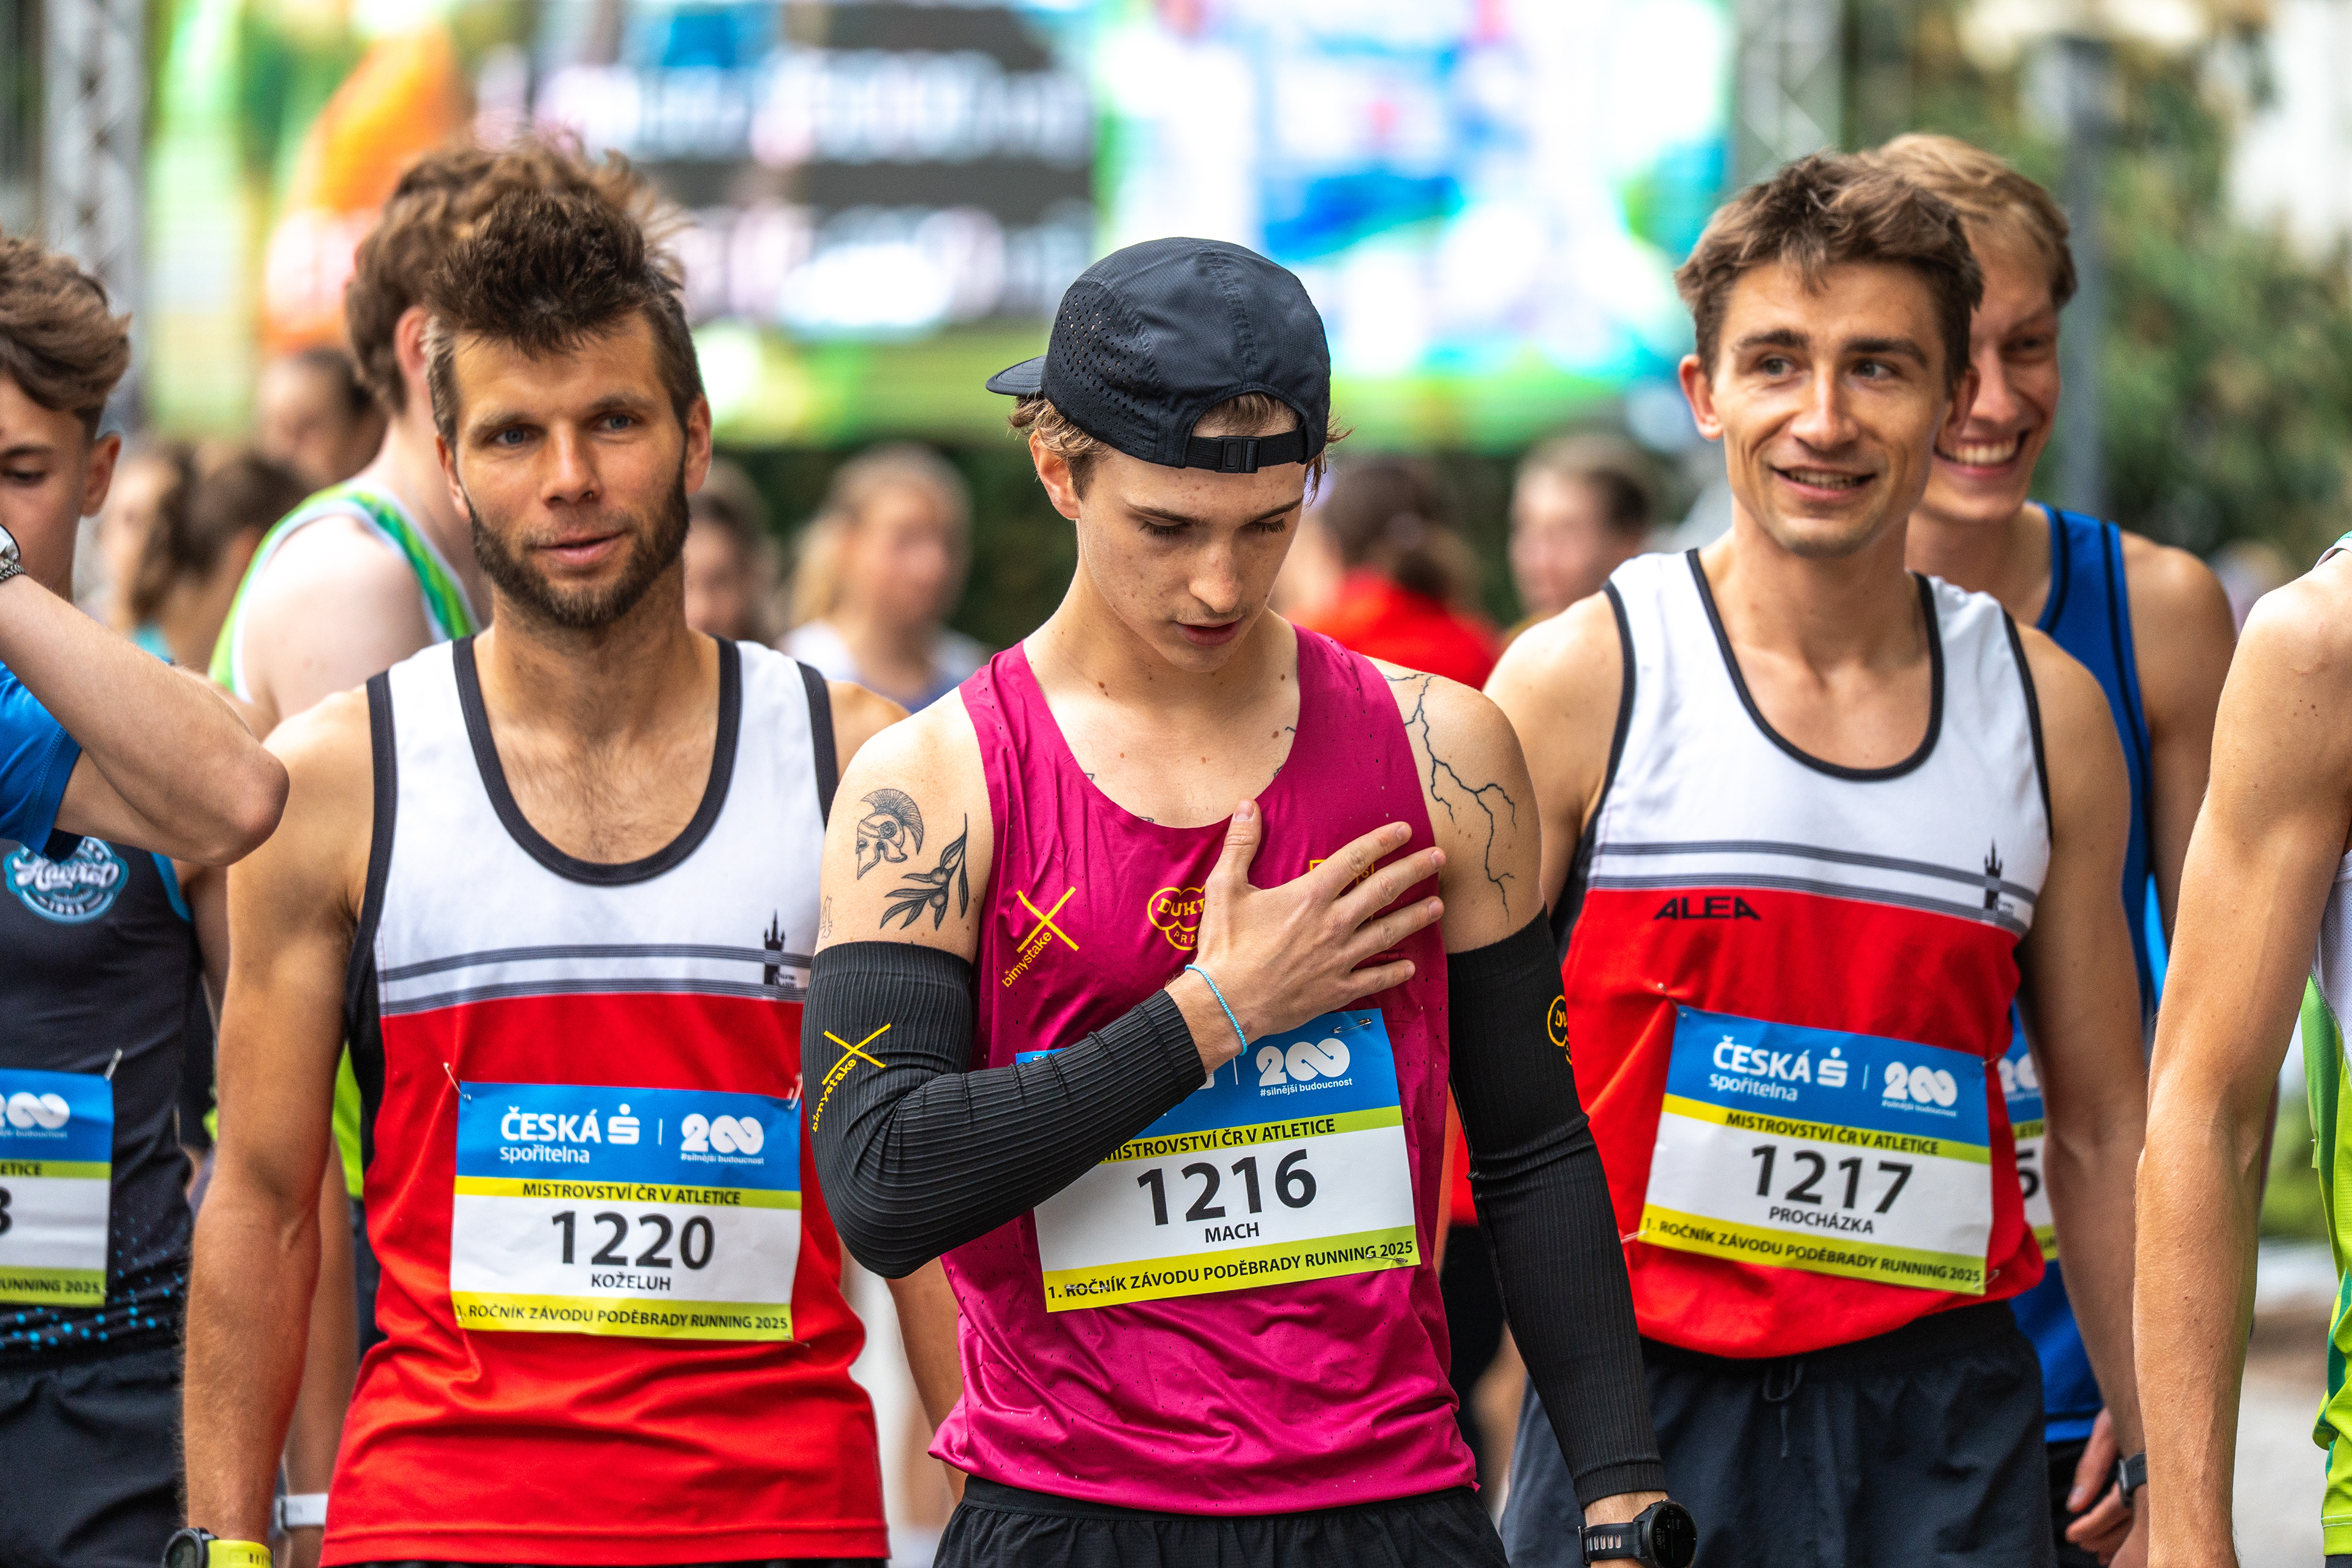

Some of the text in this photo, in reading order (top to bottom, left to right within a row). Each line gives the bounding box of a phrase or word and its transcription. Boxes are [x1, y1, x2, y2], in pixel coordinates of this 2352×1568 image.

[1653, 896, 1762, 921] ALEA
[1001, 931, 1052, 987] bimystake
[1713, 1035, 1811, 1084] ČESKÁ
[812, 1058, 857, 1133] bimystake
[1261, 1077, 1352, 1097] #silnější budoucnost
[1709, 1073, 1798, 1102] spořitelna
[500, 1106, 601, 1144] ČESKÁ
[1222, 1129, 1243, 1146] ČR
[1247, 1128, 1257, 1142] V
[1262, 1118, 1335, 1140] ATLETICE
[1726, 1112, 1939, 1155] MISTROVSTVÍ ČR V ATLETICE
[500, 1144, 590, 1164] spořitelna
[718, 1155, 764, 1165] budoucnost
[523, 1183, 742, 1205] MISTROVSTVÍ ČR V ATLETICE
[1137, 1148, 1317, 1226] 1216
[1751, 1144, 1913, 1215] 1217
[1205, 1222, 1259, 1243] MACH
[1769, 1206, 1874, 1234] PROCHÁZKA
[552, 1210, 715, 1271] 1220
[1659, 1219, 1715, 1243] ROČNÍK
[1717, 1233, 1782, 1255] ZÁVODU
[1785, 1243, 1877, 1268] PODĚBRADY
[1879, 1257, 1947, 1280] RUNNING
[1949, 1266, 1981, 1282] 2025
[591, 1272, 671, 1291] KOŽELUH
[1048, 1241, 1413, 1299] 1. ROČNÍK ZÁVODU PODĚBRADY RUNNING 2025
[469, 1303, 524, 1319] ROČNÍK
[530, 1305, 593, 1322] ZÁVODU
[598, 1308, 687, 1326] PODĚBRADY
[691, 1314, 752, 1329] RUNNING
[755, 1316, 788, 1329] 2025
